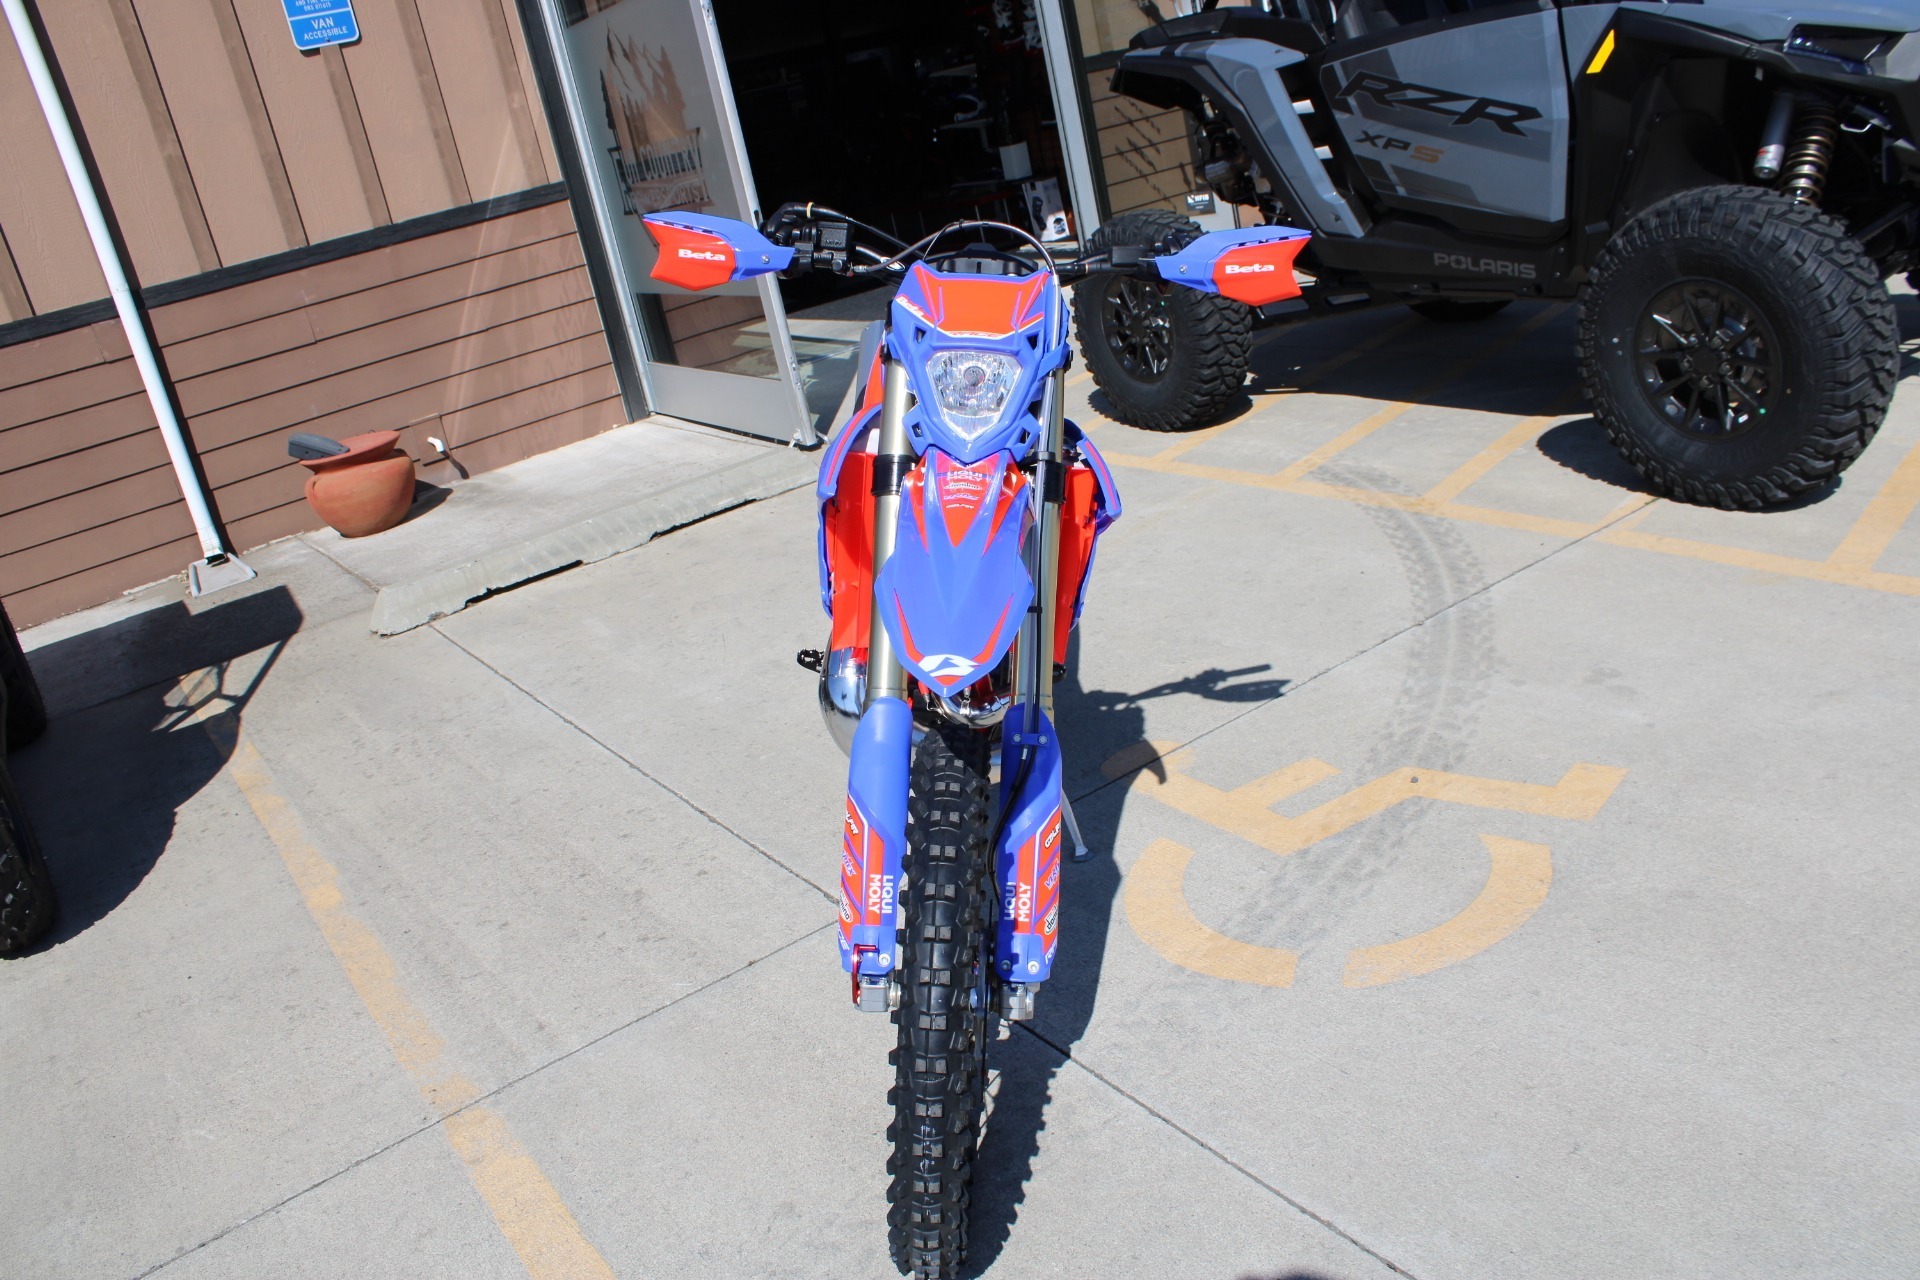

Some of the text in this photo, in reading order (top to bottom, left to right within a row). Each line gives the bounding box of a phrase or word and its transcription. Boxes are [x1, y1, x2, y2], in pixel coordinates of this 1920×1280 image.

[304, 26, 348, 40] ACCESSIBLE
[311, 17, 334, 30] VAN
[1335, 70, 1544, 137] RZR
[678, 248, 726, 261] Beta
[1434, 253, 1536, 279] POLARIS
[1225, 263, 1275, 274] Beta
[946, 470, 983, 478] LIQUI
[868, 874, 881, 914] MOLY
[881, 874, 893, 914] LIQUI
[1004, 881, 1016, 920] LIQUI
[1018, 882, 1031, 922] MOLY
